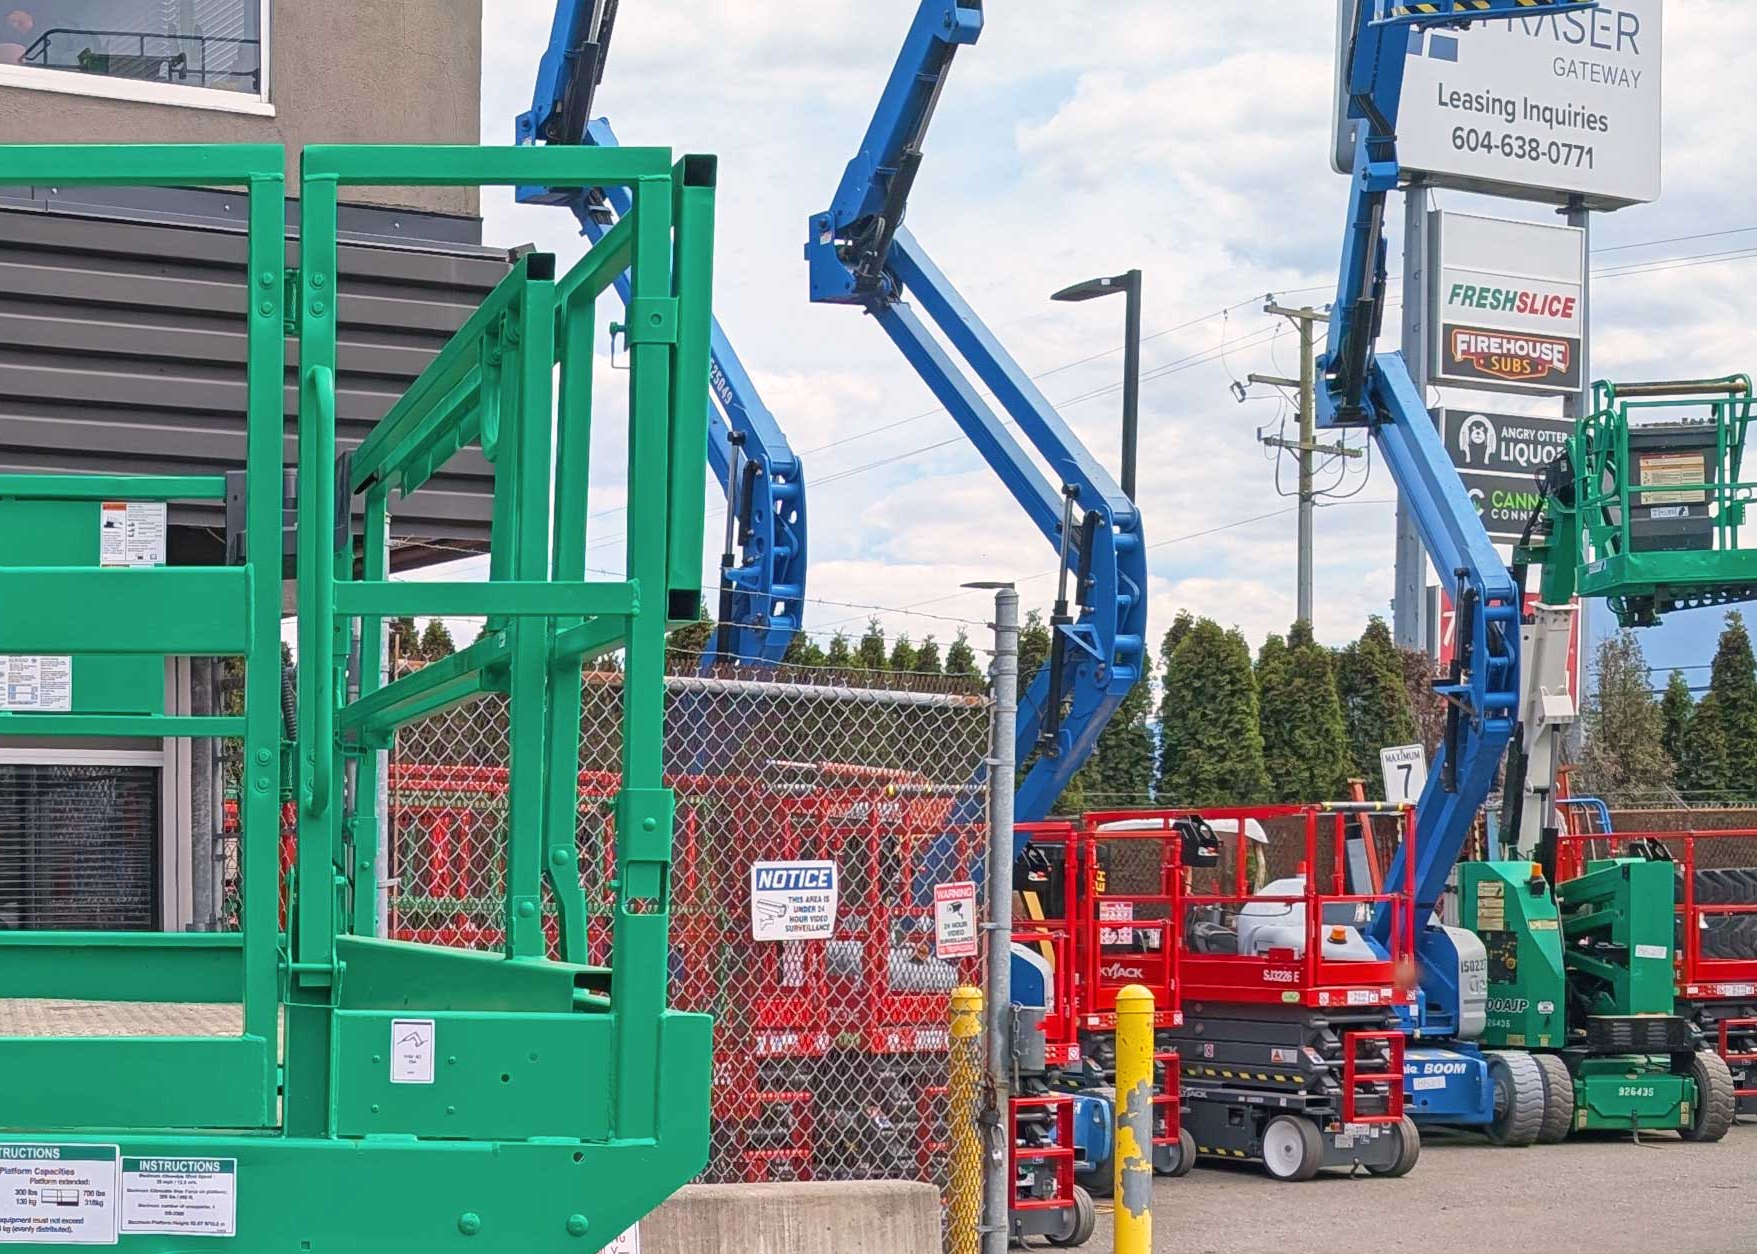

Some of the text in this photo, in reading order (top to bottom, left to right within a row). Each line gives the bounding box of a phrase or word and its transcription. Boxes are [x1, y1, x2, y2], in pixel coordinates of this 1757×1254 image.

[1553, 56, 1641, 88] GATEWAY
[1438, 82, 1608, 132] Leasing Inquiries
[1452, 126, 1594, 169] 604-638-0771
[1448, 283, 1576, 318] FRESHSLICE
[1455, 333, 1566, 373] FIREHOUSE
[1491, 355, 1532, 374] SUBS
[1501, 426, 1536, 441] ANGRY
[1385, 751, 1420, 762] MAXIMUM
[1397, 764, 1412, 798] 7
[758, 869, 830, 889] NOTICE
[805, 895, 822, 903] AREA
[824, 895, 830, 903] IS
[937, 887, 972, 900] WARNING
[793, 905, 825, 913] UNDER 24
[789, 915, 828, 923] HOUR VIDEO
[951, 921, 967, 929] HOUR
[785, 923, 830, 933] SURVEILLANCE
[947, 929, 965, 937] VIDEO
[1294, 971, 1300, 984] E
[1424, 1063, 1466, 1075] BOOM
[1618, 1086, 1654, 1097] 926435
[0, 1166, 32, 1175] Platform
[34, 1167, 75, 1177] Capacities
[139, 1160, 220, 1172] INSTRUCTIONS
[30, 1177, 57, 1185] Platform
[29, 1199, 36, 1207] kg
[3, 1225, 11, 1234] kg
